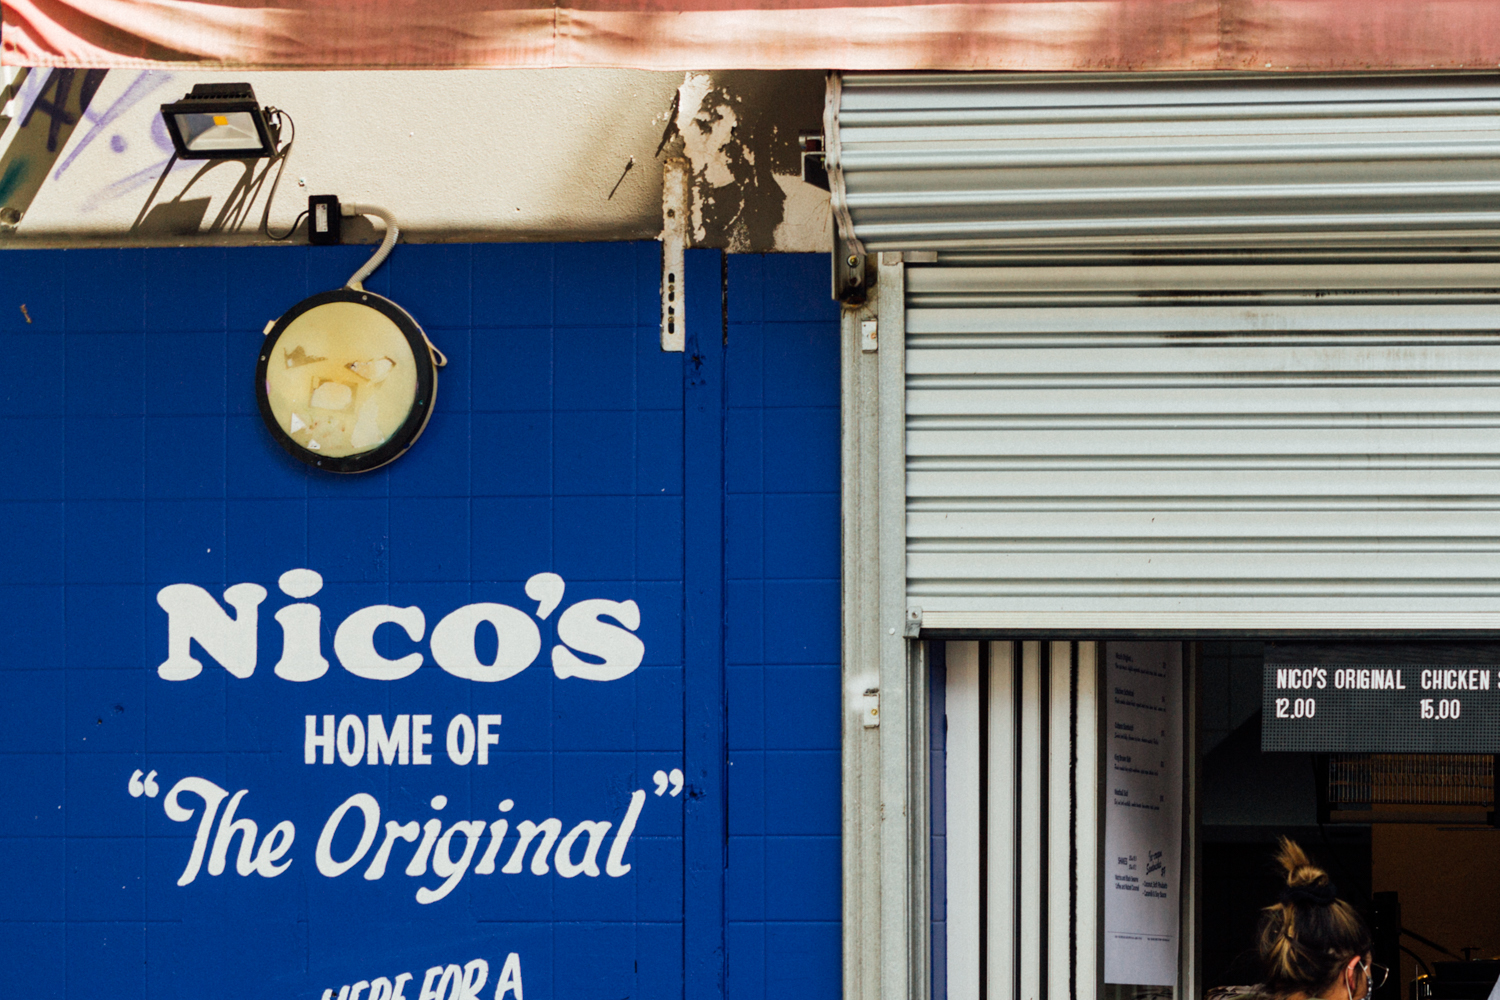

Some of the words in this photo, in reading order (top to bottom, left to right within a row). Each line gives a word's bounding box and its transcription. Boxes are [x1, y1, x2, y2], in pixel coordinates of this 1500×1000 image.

[157, 568, 645, 682] Nico's
[1277, 668, 1327, 690] NICO'S
[1335, 668, 1405, 690] ORIGINAL
[1421, 669, 1489, 691] CHICKEN
[1276, 698, 1316, 719] 12.00
[1420, 699, 1461, 720] 15.00
[304, 714, 432, 765] HOME
[447, 714, 502, 765] OF
